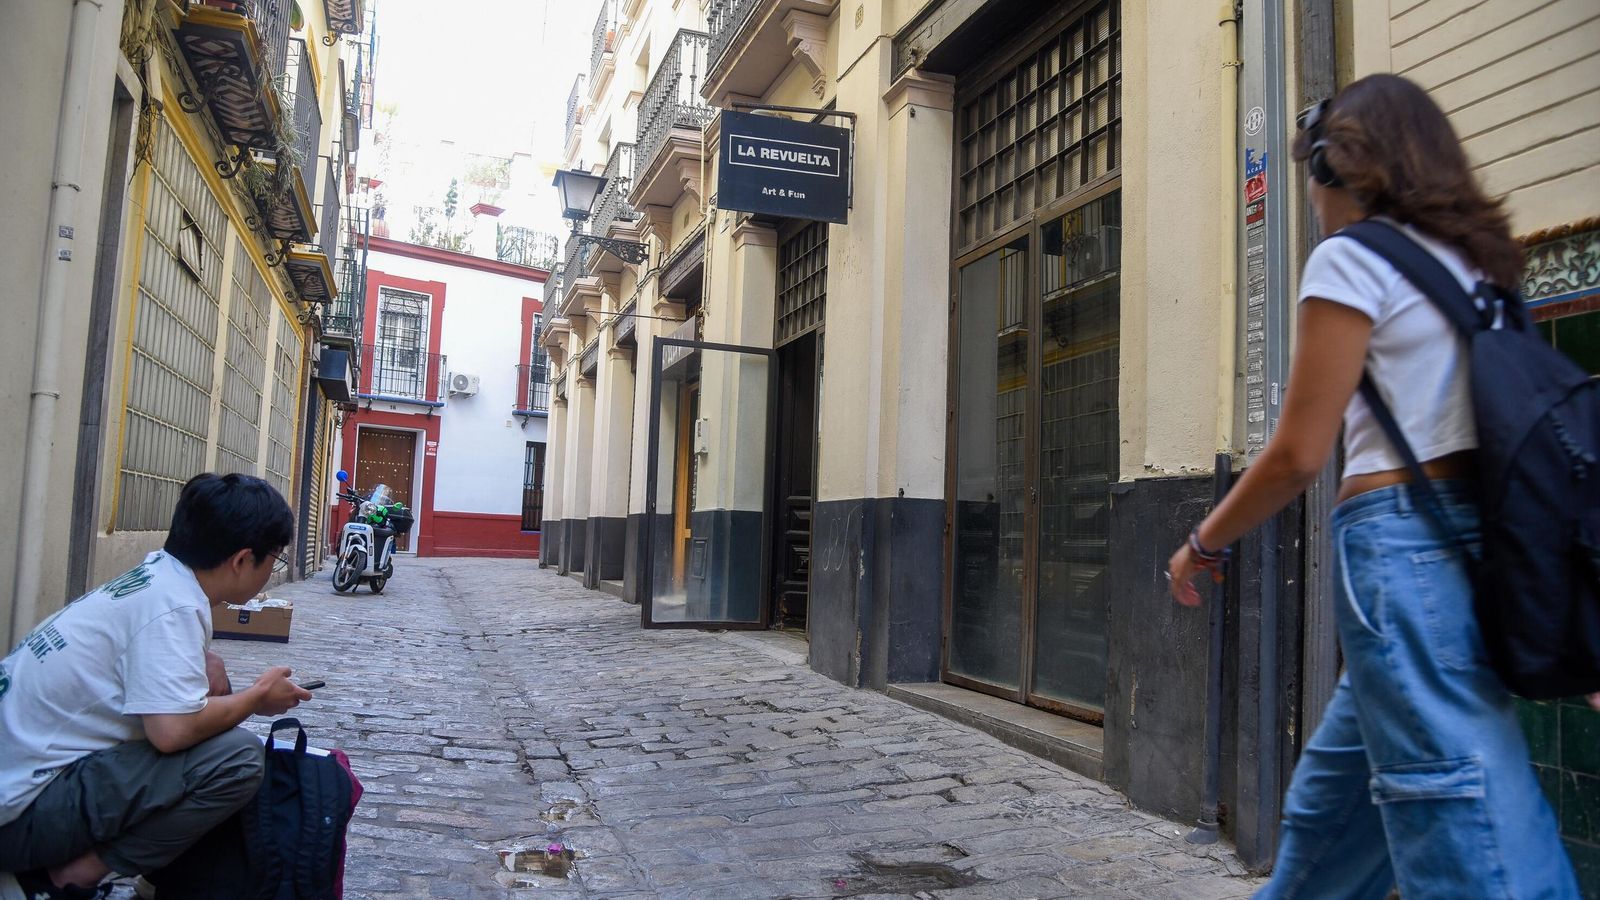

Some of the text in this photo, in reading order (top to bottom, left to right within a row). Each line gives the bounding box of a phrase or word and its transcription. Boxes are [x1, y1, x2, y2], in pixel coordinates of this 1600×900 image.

[738, 145, 831, 167] LA REVUELTA
[762, 187, 776, 196] Art
[788, 190, 805, 199] Fun
[28, 634, 52, 663] CONF.
